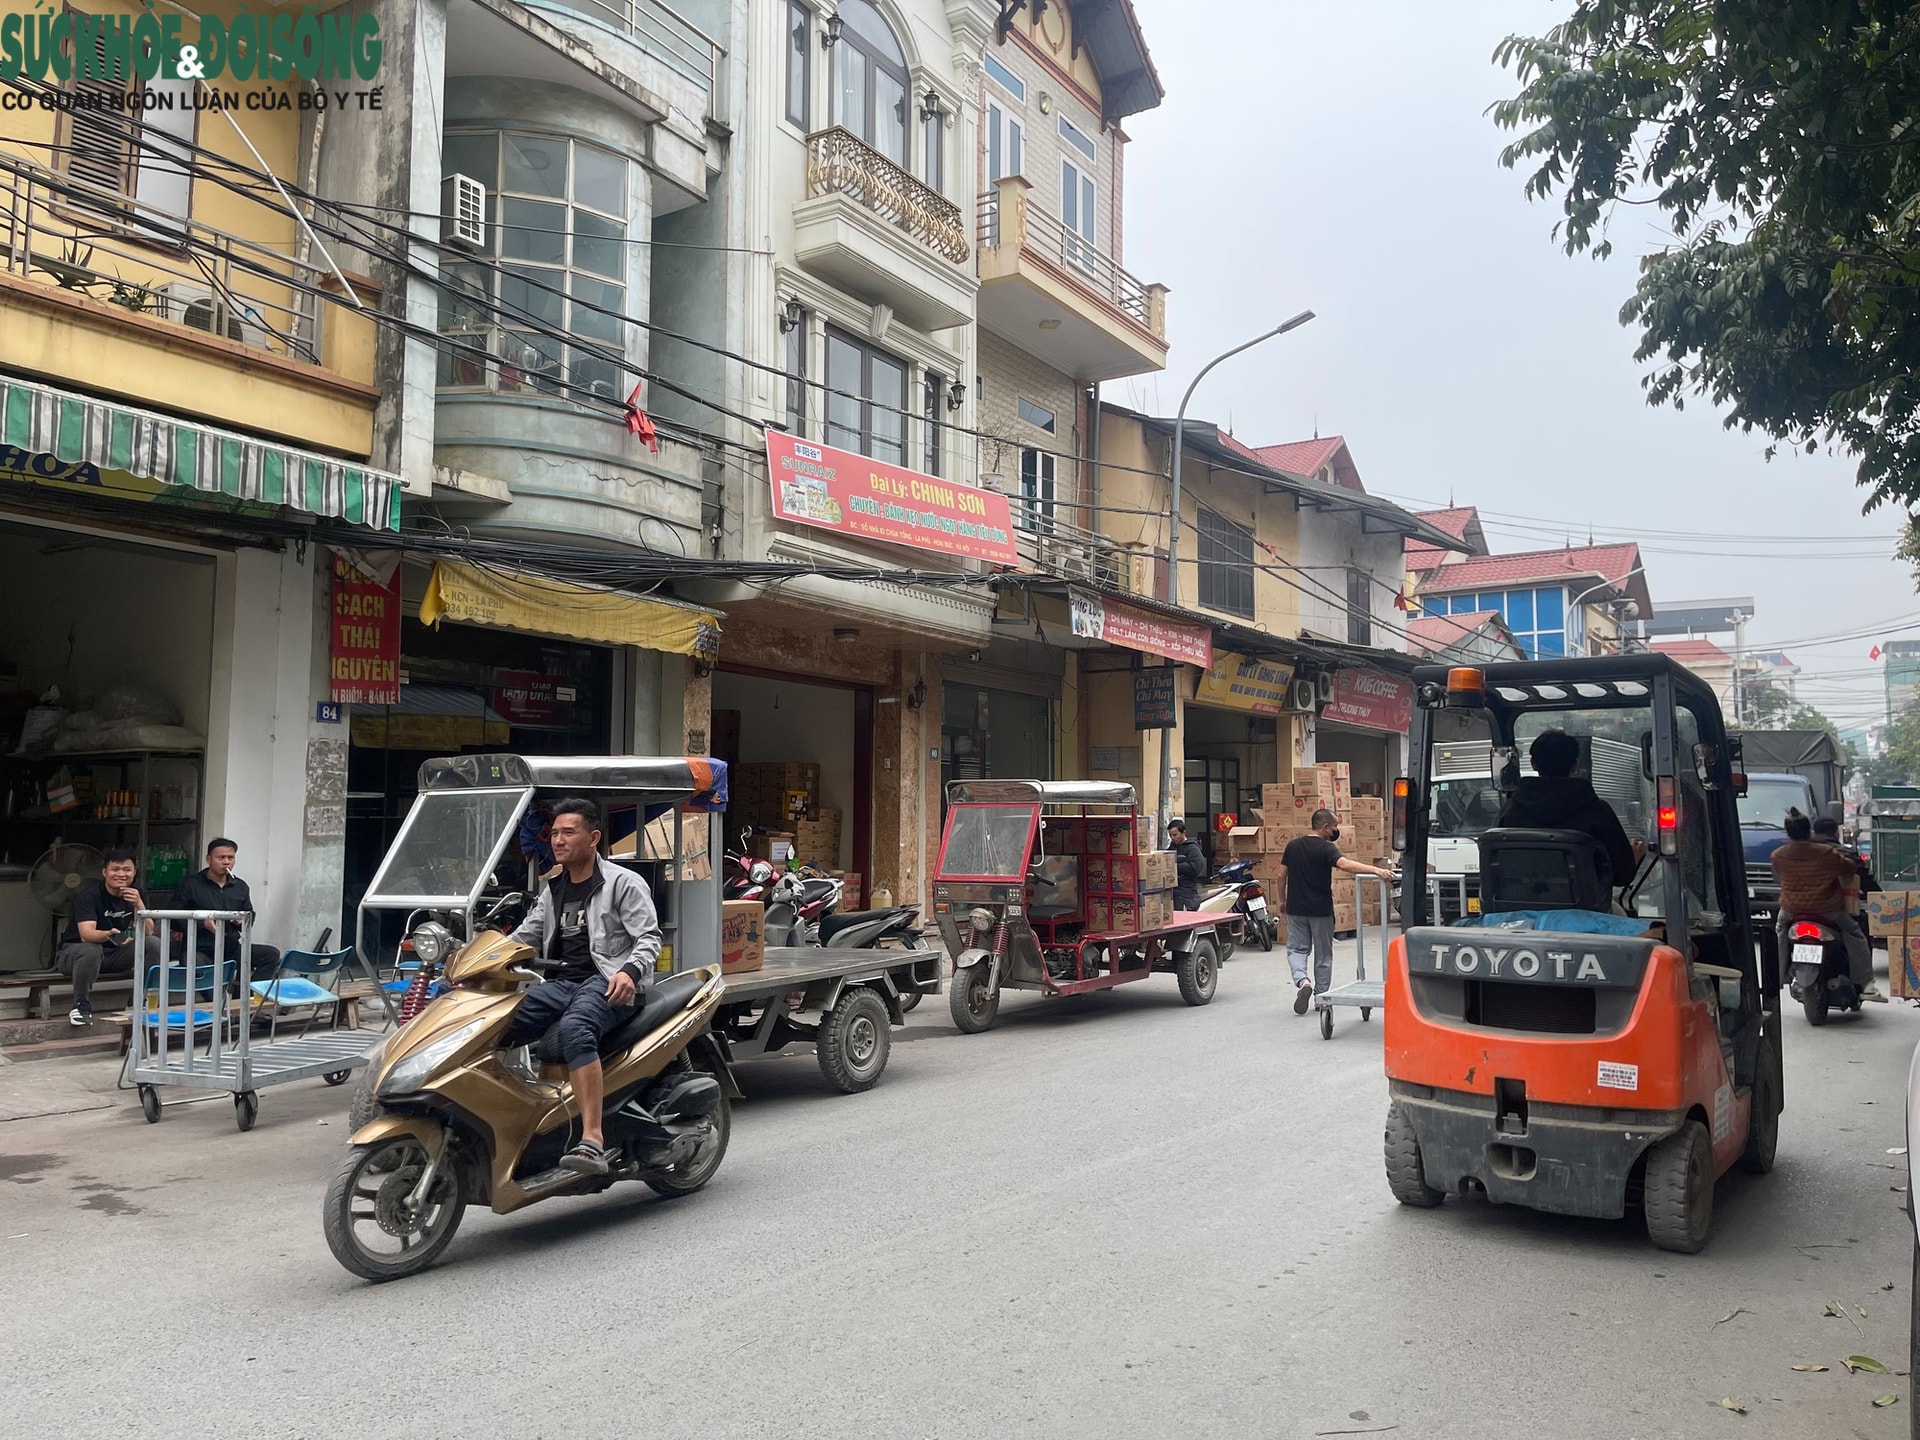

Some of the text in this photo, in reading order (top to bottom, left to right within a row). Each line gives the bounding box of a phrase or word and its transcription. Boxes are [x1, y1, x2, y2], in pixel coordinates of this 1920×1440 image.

[870, 473, 889, 494] Đại
[911, 480, 954, 509] CHINH
[957, 491, 986, 516] SƠN
[849, 494, 879, 516] CHUYÊN
[905, 509, 919, 529] KẸO
[940, 516, 956, 537] NGỌT
[958, 518, 976, 538] HÀNG
[991, 525, 1008, 545] DÙNG
[336, 592, 385, 620] SẠCH
[451, 590, 468, 603] KCN
[475, 595, 486, 606] LA
[340, 623, 380, 648] THÁI
[1120, 616, 1133, 627] MAY
[1149, 623, 1163, 635] THÊU
[368, 687, 384, 704] BÁN
[1354, 674, 1374, 694] KING
[1372, 680, 1399, 699] COFFEE
[322, 705, 337, 720] 84
[1430, 943, 1608, 981] TOYOTA
